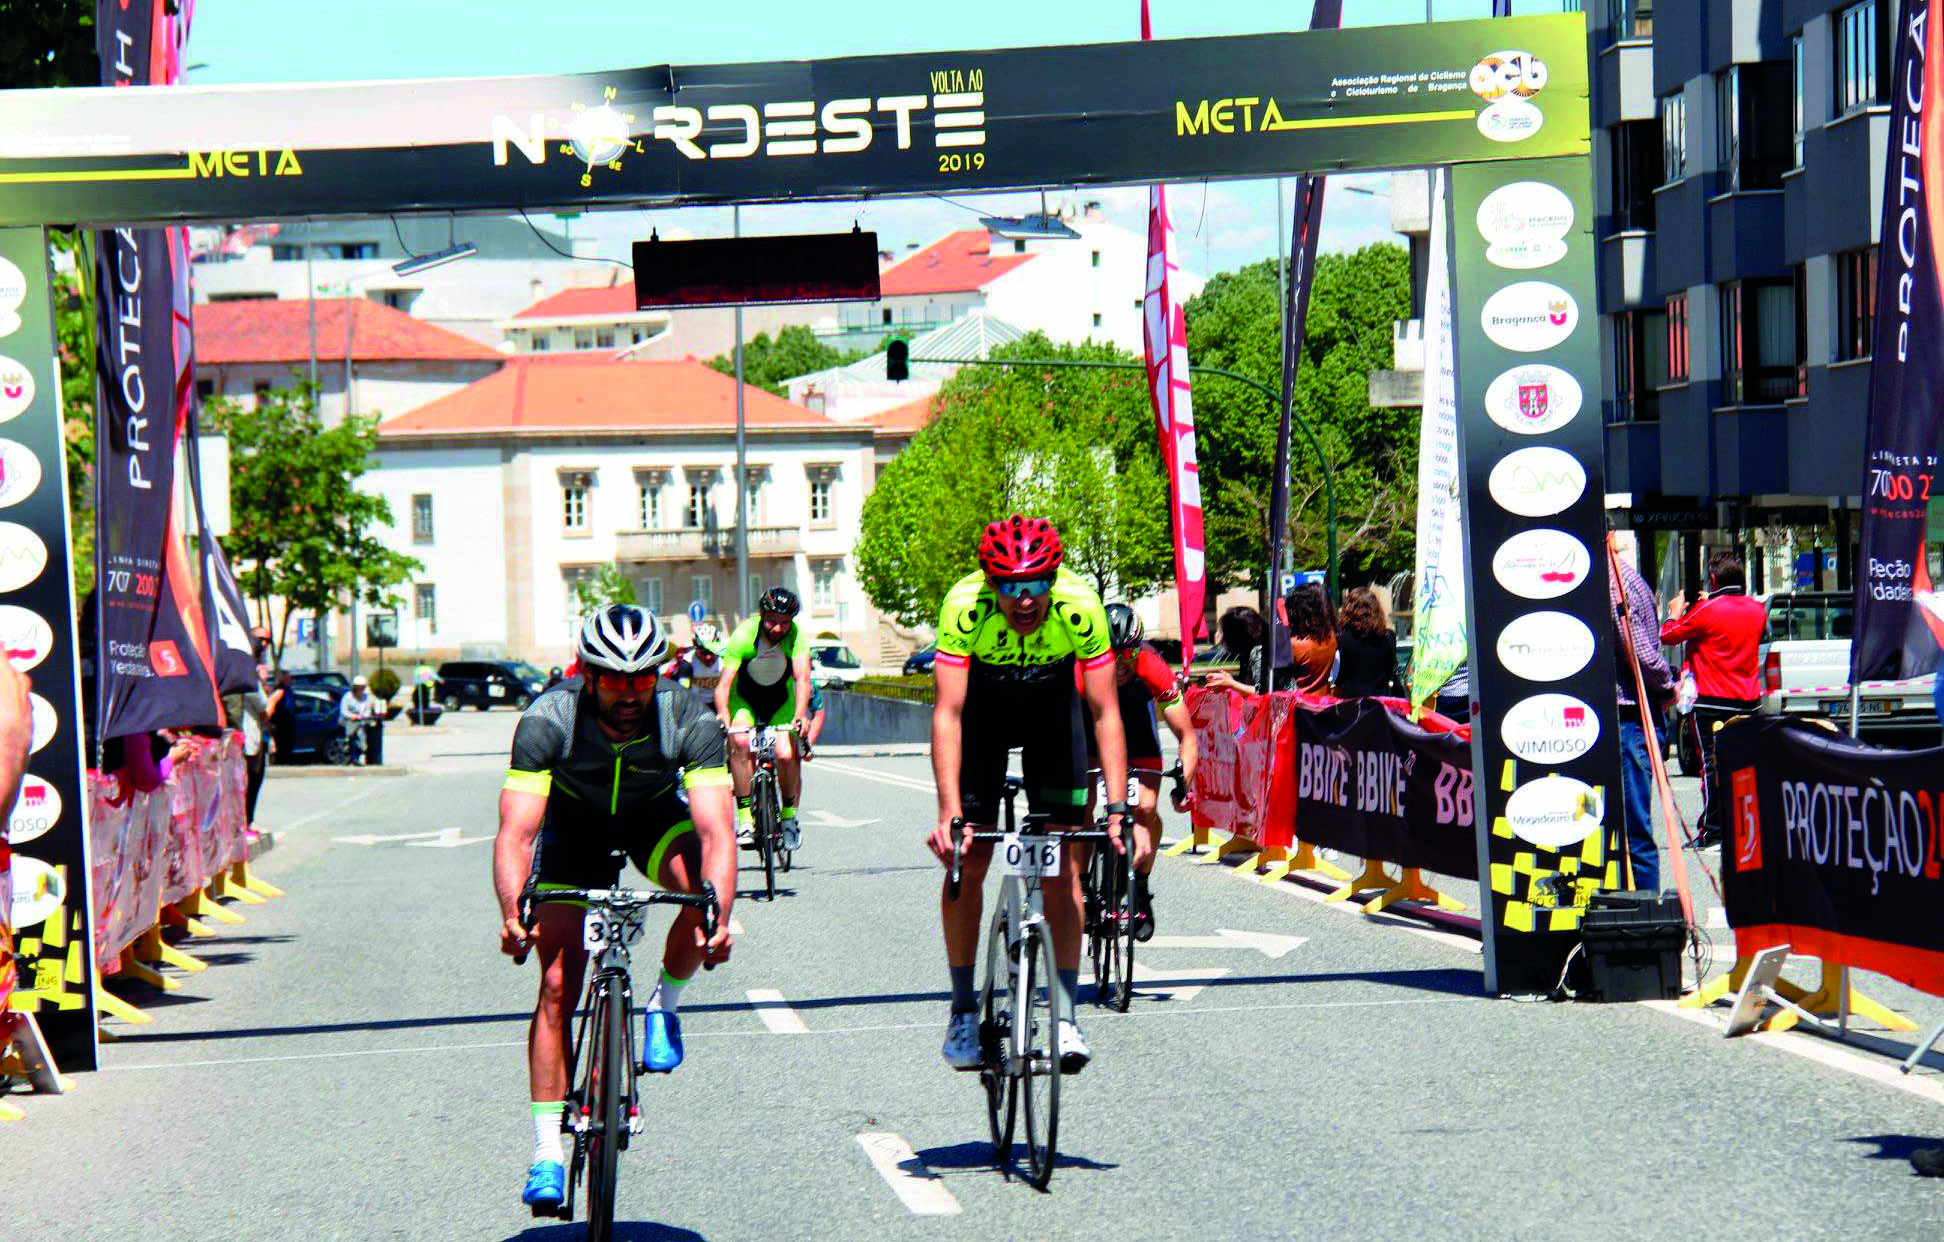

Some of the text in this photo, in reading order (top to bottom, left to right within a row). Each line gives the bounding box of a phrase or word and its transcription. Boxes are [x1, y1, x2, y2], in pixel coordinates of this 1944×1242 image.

[930, 69, 984, 93] VOLTA AO
[1331, 76, 1380, 87] Associação
[1380, 73, 1417, 85] Regional
[1176, 96, 1284, 136] META
[187, 146, 303, 178] META
[939, 152, 986, 173] 2019
[1514, 738, 1587, 754] VIMIOSO
[1007, 844, 1055, 866] 016
